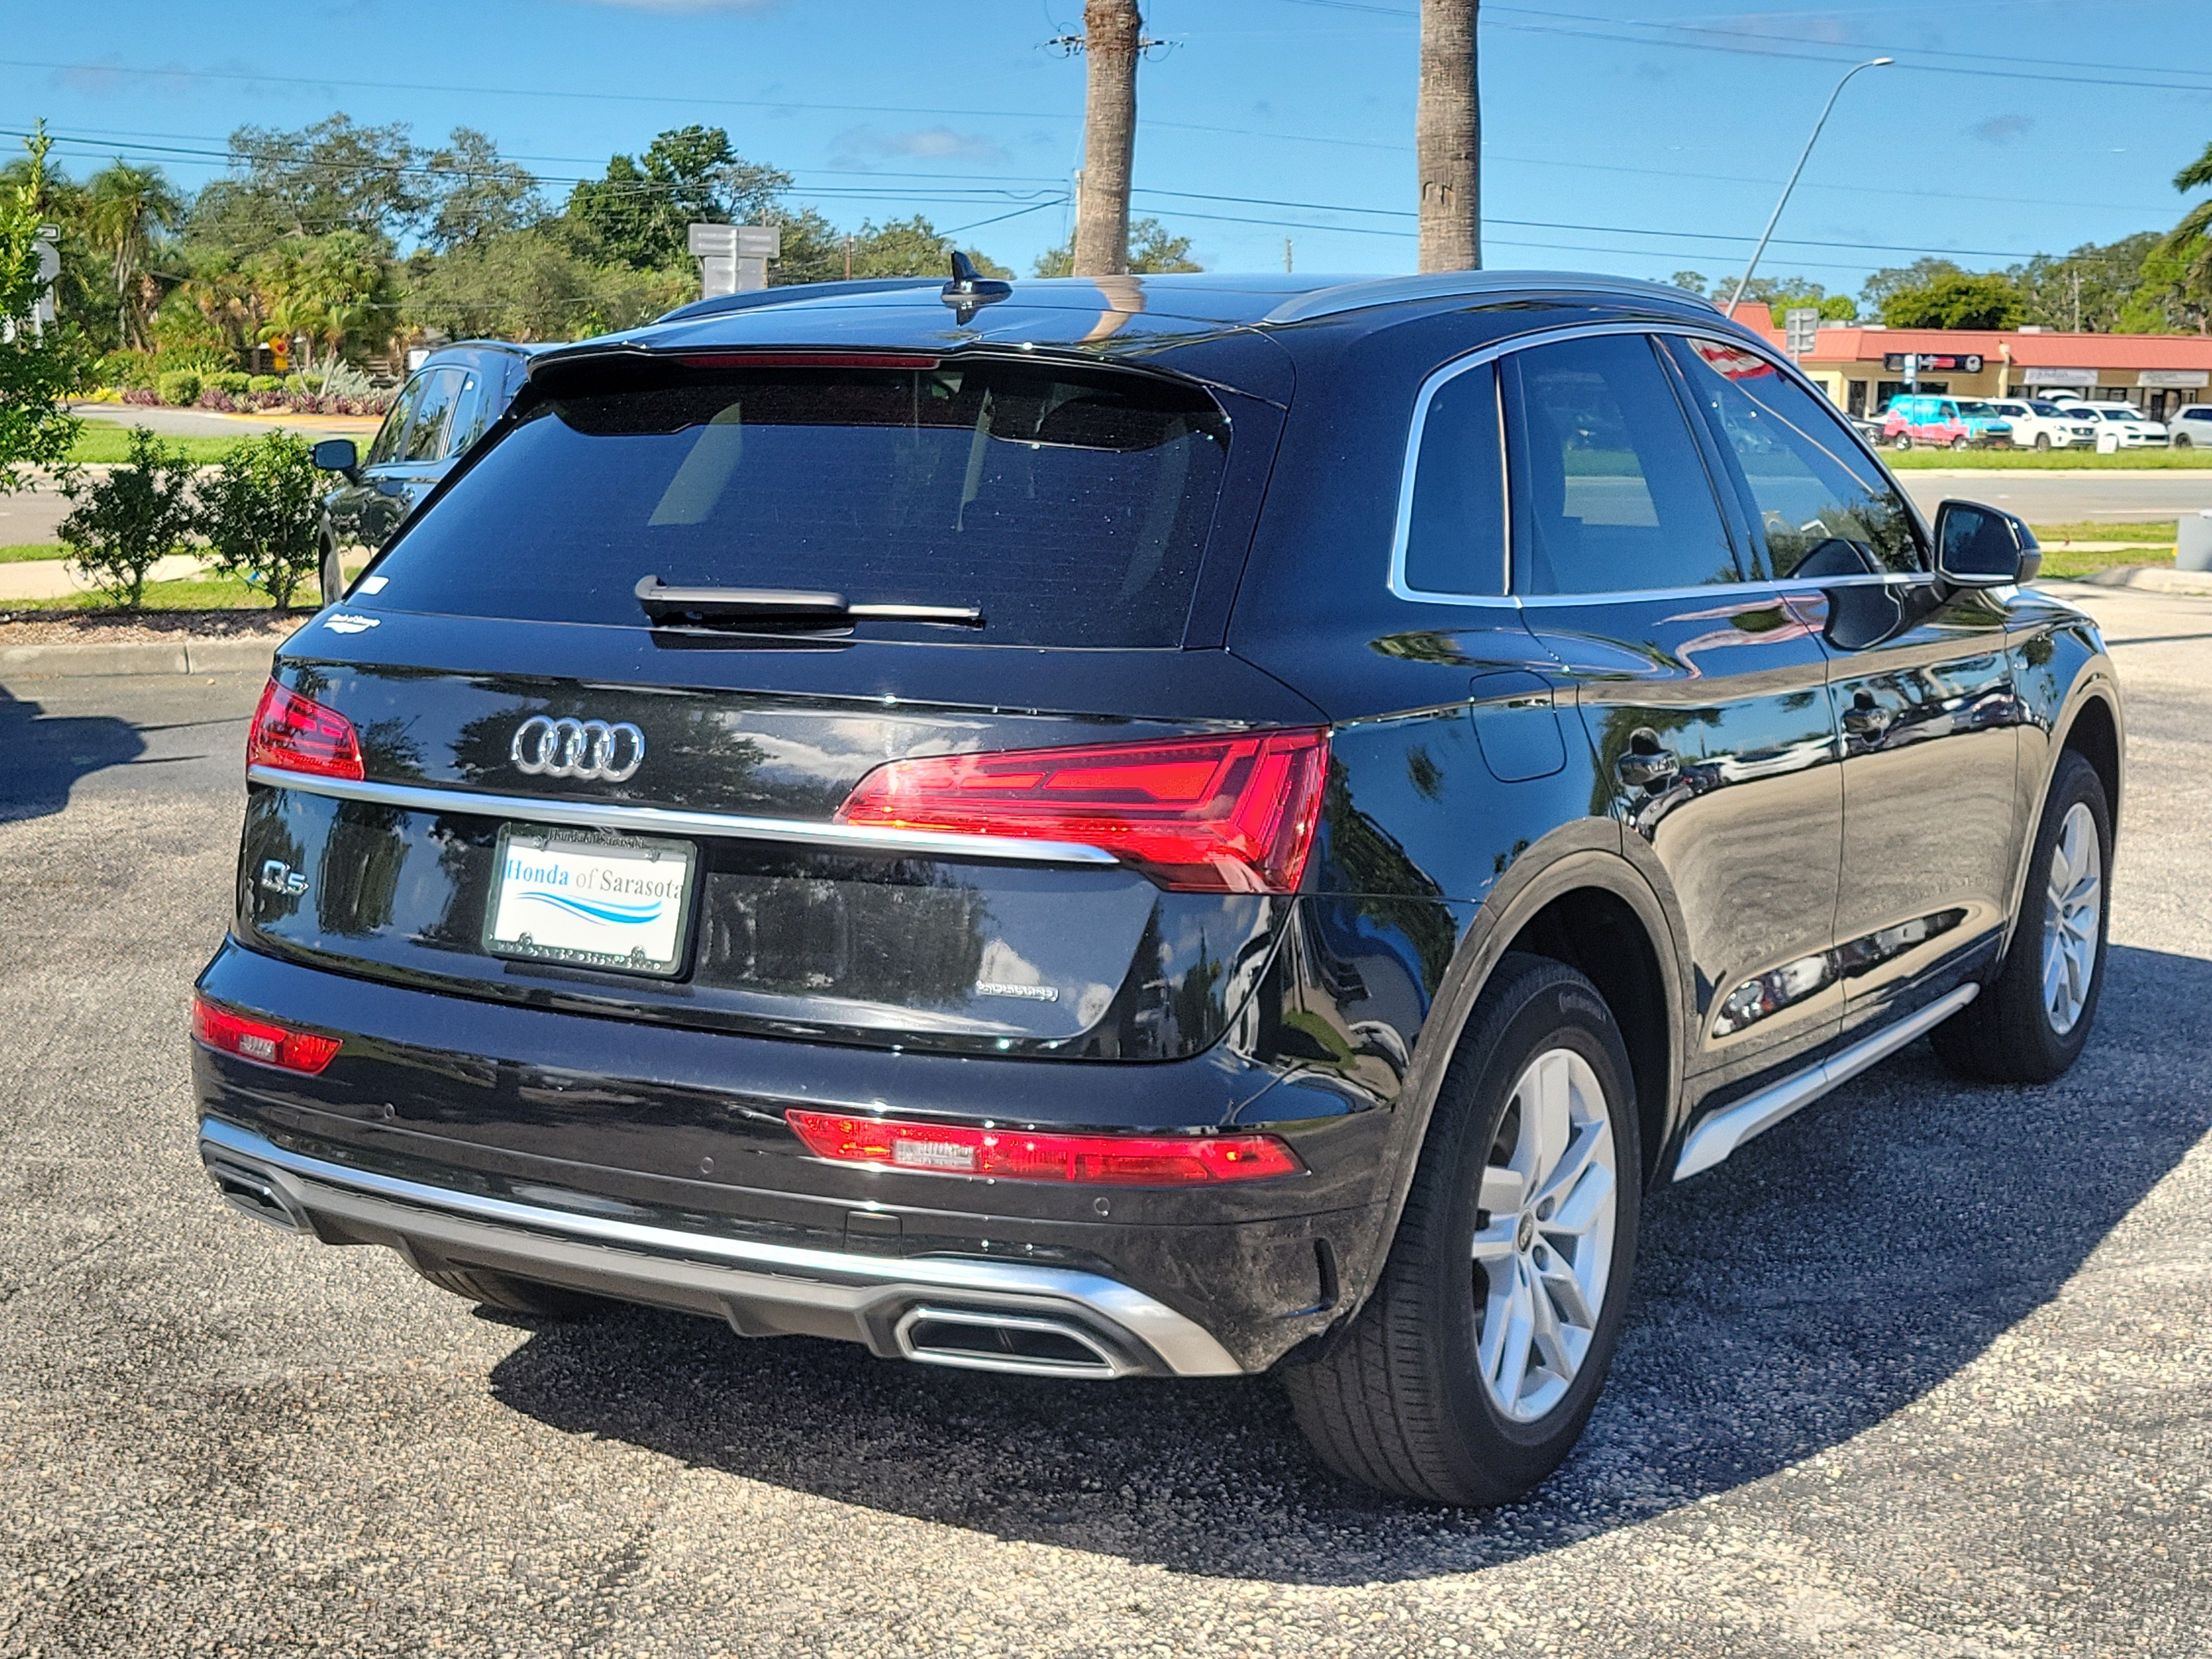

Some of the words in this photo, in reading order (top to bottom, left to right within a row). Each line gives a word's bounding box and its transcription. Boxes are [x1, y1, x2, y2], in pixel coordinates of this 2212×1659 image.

[262, 859, 309, 896] Q5
[507, 859, 569, 885] Honda
[576, 867, 598, 889] of
[600, 869, 684, 899] Sarasota
